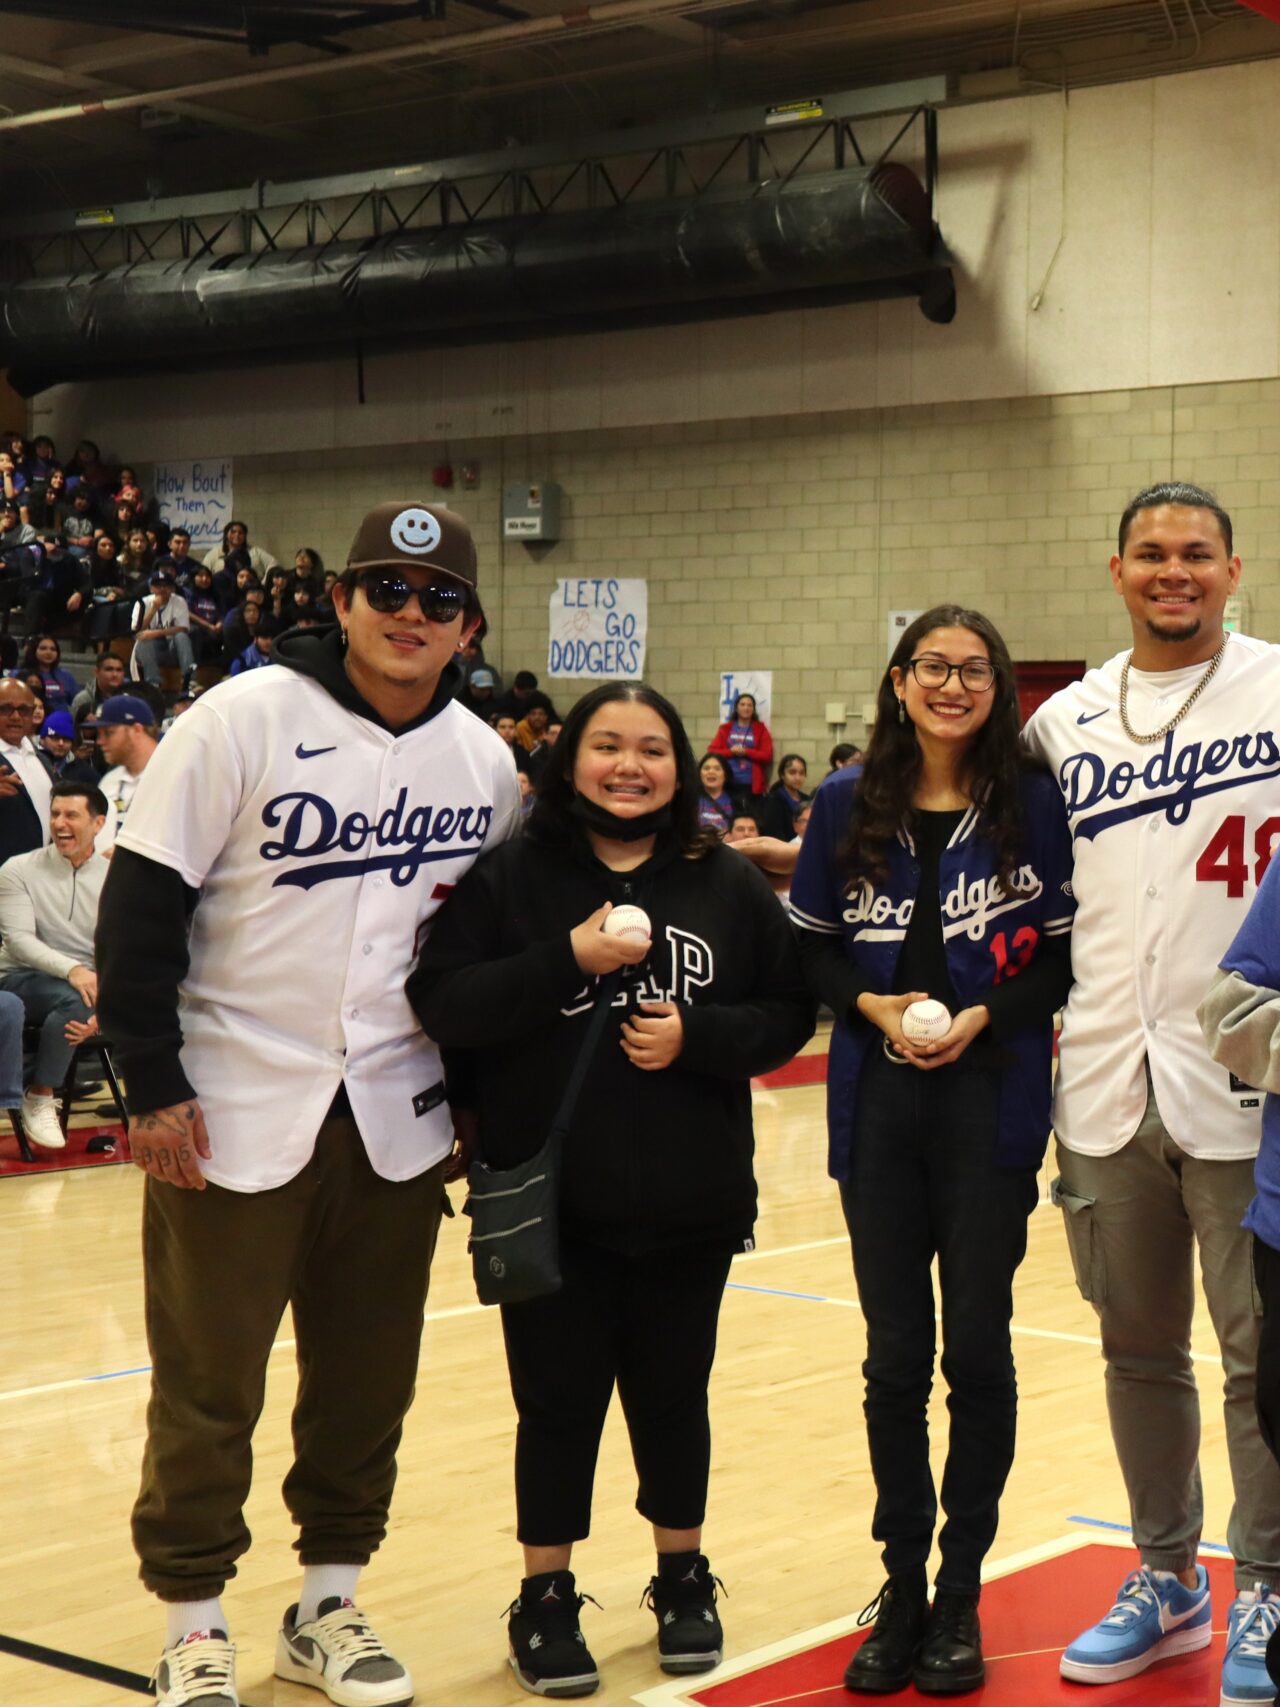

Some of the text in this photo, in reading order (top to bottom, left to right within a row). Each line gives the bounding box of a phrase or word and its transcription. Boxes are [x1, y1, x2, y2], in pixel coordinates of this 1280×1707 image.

[156, 466, 184, 494] How
[175, 496, 205, 514] Them
[563, 579, 619, 609] LETS
[605, 611, 636, 640] GO
[551, 639, 640, 674] DODGERS
[260, 787, 493, 887] Dodgers
[990, 926, 1038, 986] 13
